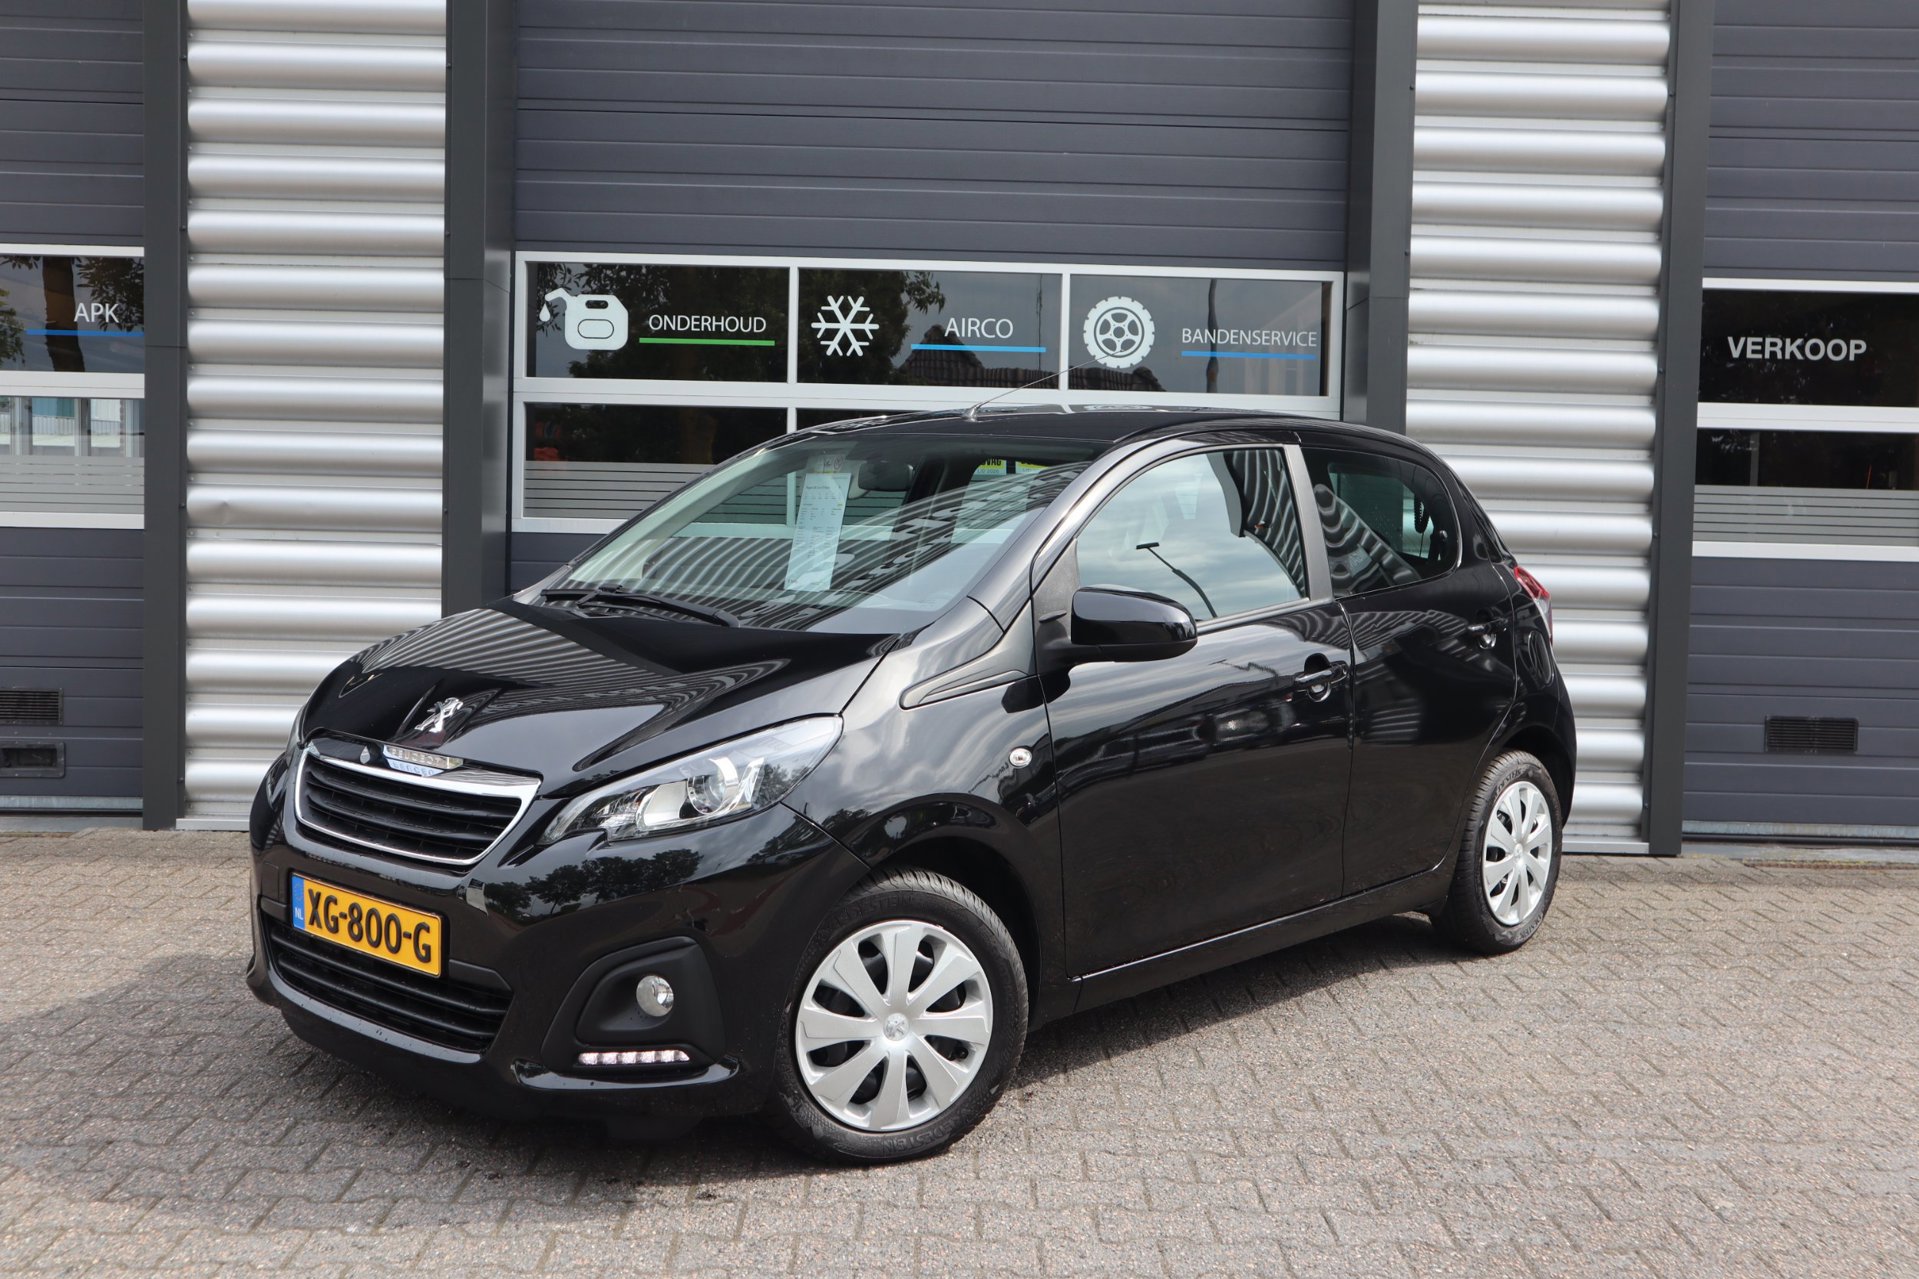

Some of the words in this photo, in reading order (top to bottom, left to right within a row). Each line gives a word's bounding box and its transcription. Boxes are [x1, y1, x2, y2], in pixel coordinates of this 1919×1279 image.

[74, 302, 119, 323] APK
[648, 314, 767, 334] ONDERHOUD
[944, 317, 1014, 340] AIRCO
[1181, 327, 1318, 348] BANDENSERVICE
[1727, 336, 1867, 361] VERKOOP
[294, 907, 304, 920] NL
[308, 888, 432, 964] XG-800-G
